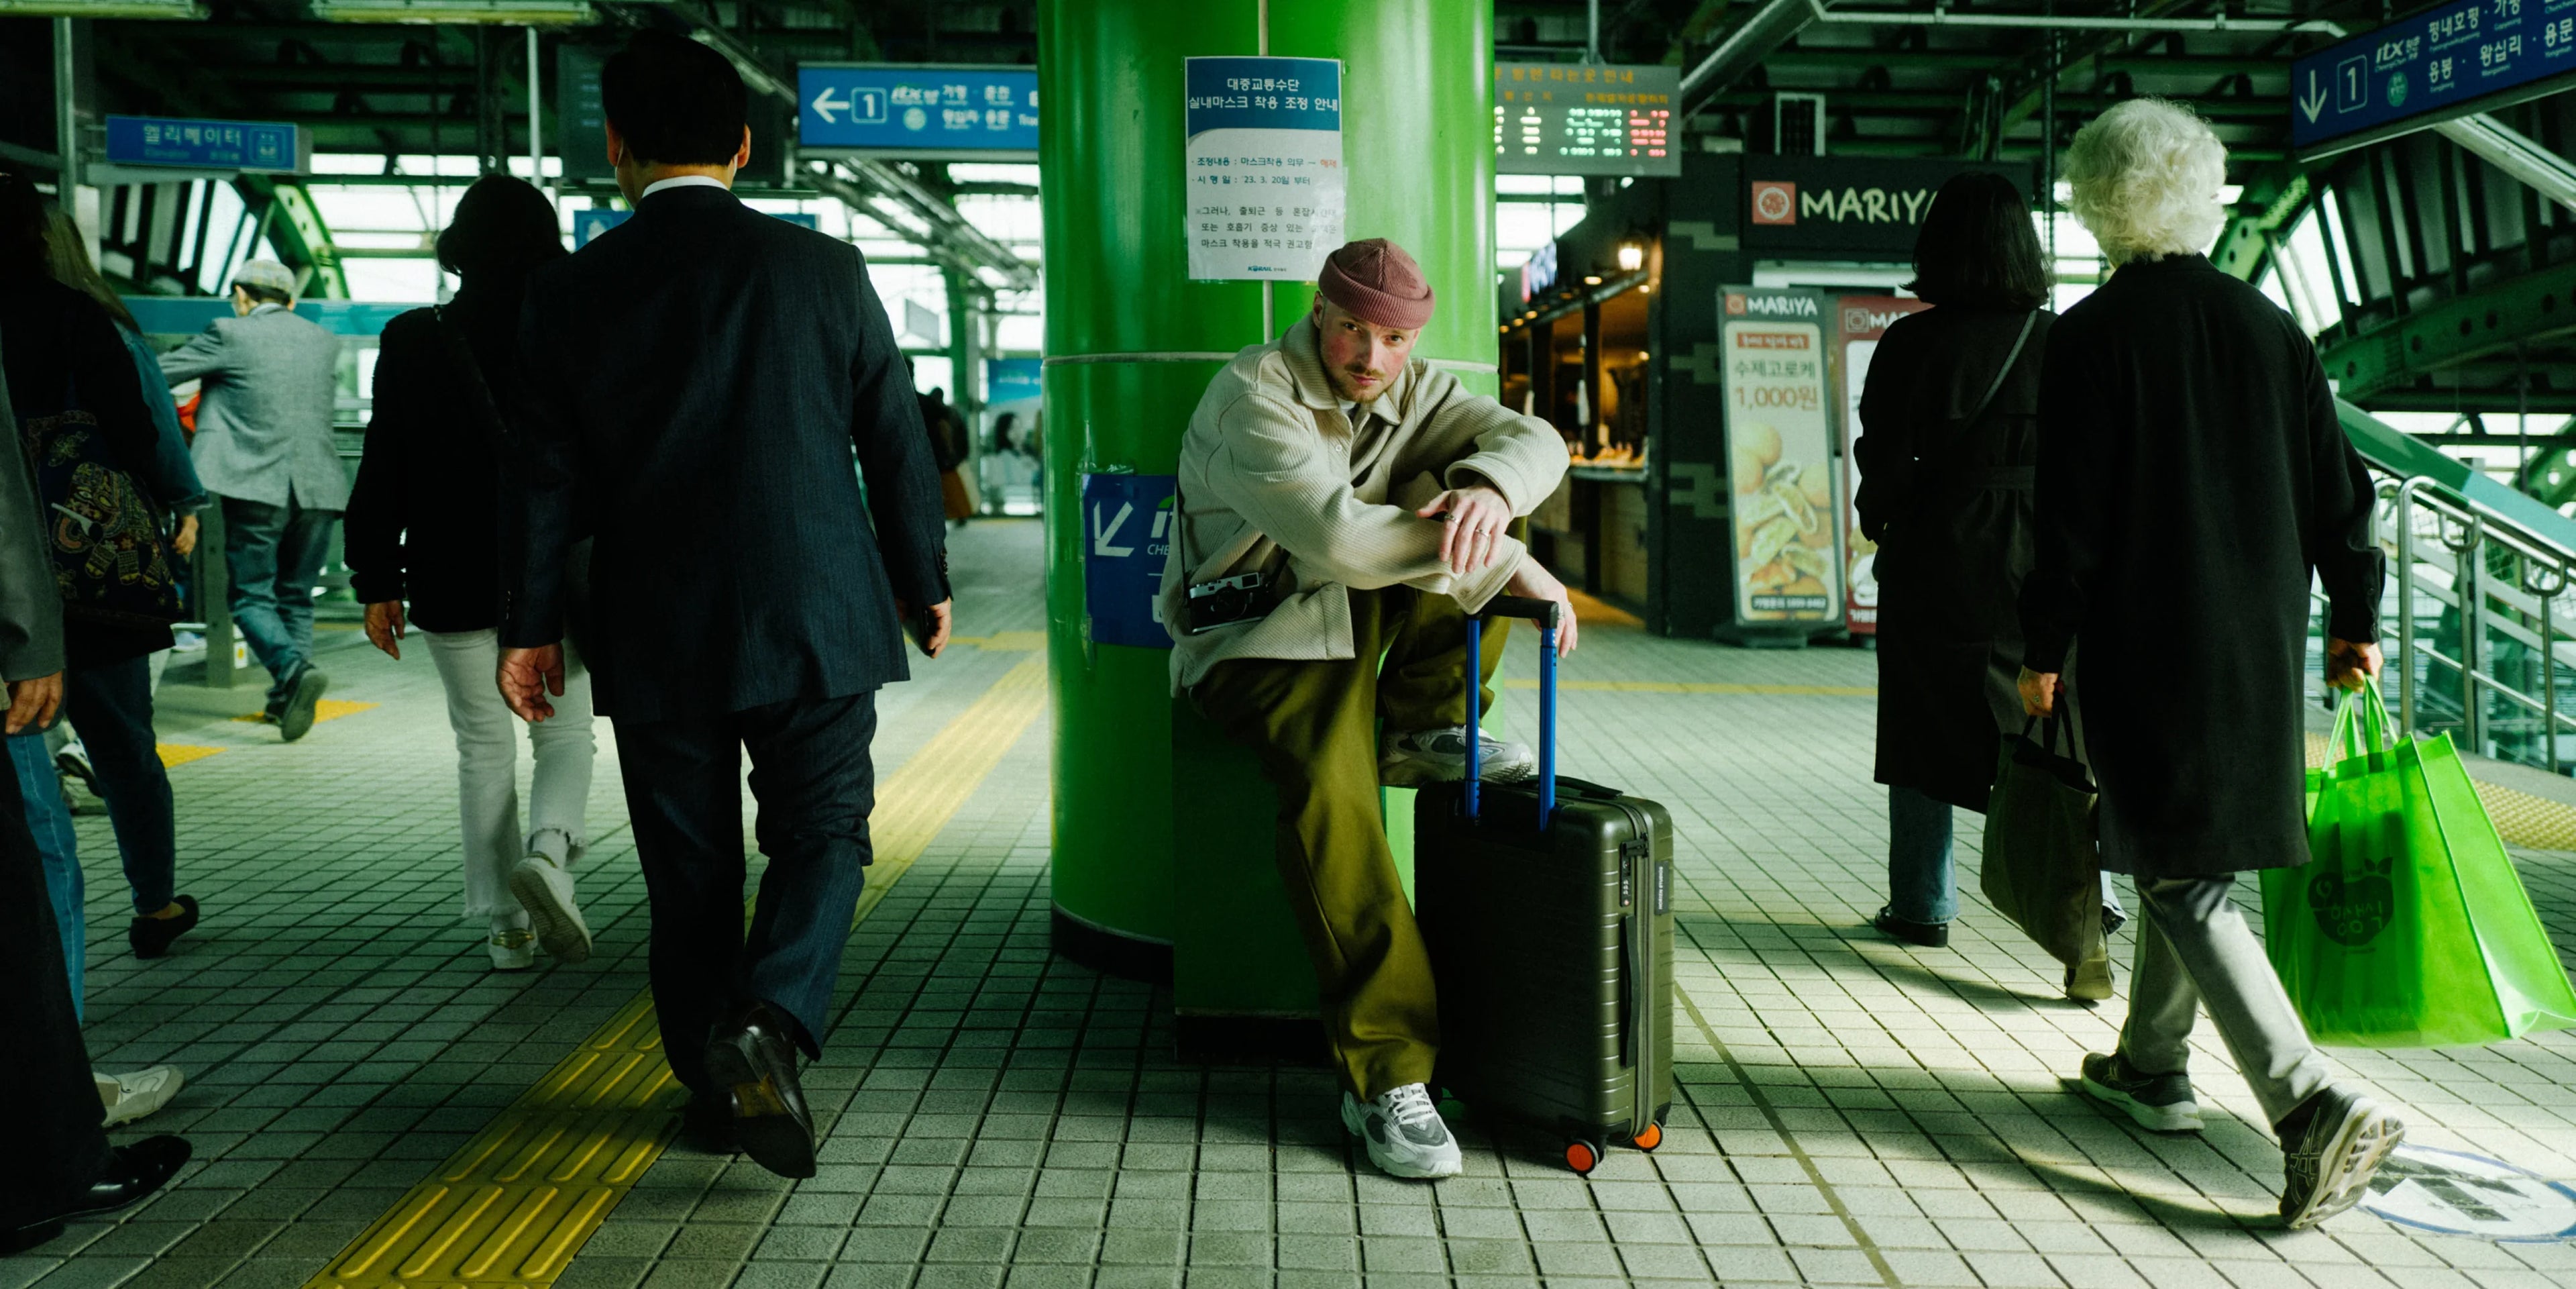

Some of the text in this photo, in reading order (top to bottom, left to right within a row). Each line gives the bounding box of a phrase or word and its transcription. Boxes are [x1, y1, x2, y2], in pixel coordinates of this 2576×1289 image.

[2429, 6, 2479, 42] 평내호평
[2429, 17, 2573, 83] 응봉 왕십리 용문
[1227, 78, 1300, 92] 대중교통수단
[2347, 67, 2355, 101] 1
[863, 94, 875, 118] 1
[1189, 96, 1338, 111] 실내마스크 착용 조정 안내
[1197, 157, 1230, 166] 조정내용
[1241, 158, 1283, 166] 마스크착용
[1287, 158, 1304, 166] 의무
[1197, 175, 1205, 184] 시
[1222, 176, 1231, 184] 일
[1271, 176, 1289, 185] 20일
[1294, 176, 1311, 185] 부터
[1239, 207, 1265, 216] 출퇴근
[1275, 207, 1283, 216] 등
[1802, 187, 1937, 224] MARIY
[1201, 223, 1218, 232] 또는
[1226, 223, 1252, 232] 호흡기
[1260, 223, 1278, 232] 증상
[1286, 223, 1303, 233] 있는
[1201, 239, 1227, 248] 마스크
[1232, 239, 1258, 248] 착용을
[1264, 240, 1281, 249] 적극
[1748, 295, 1818, 317] MARIYA
[1735, 360, 1816, 380] 수제고로케
[1735, 386, 1817, 411] 1,000원
